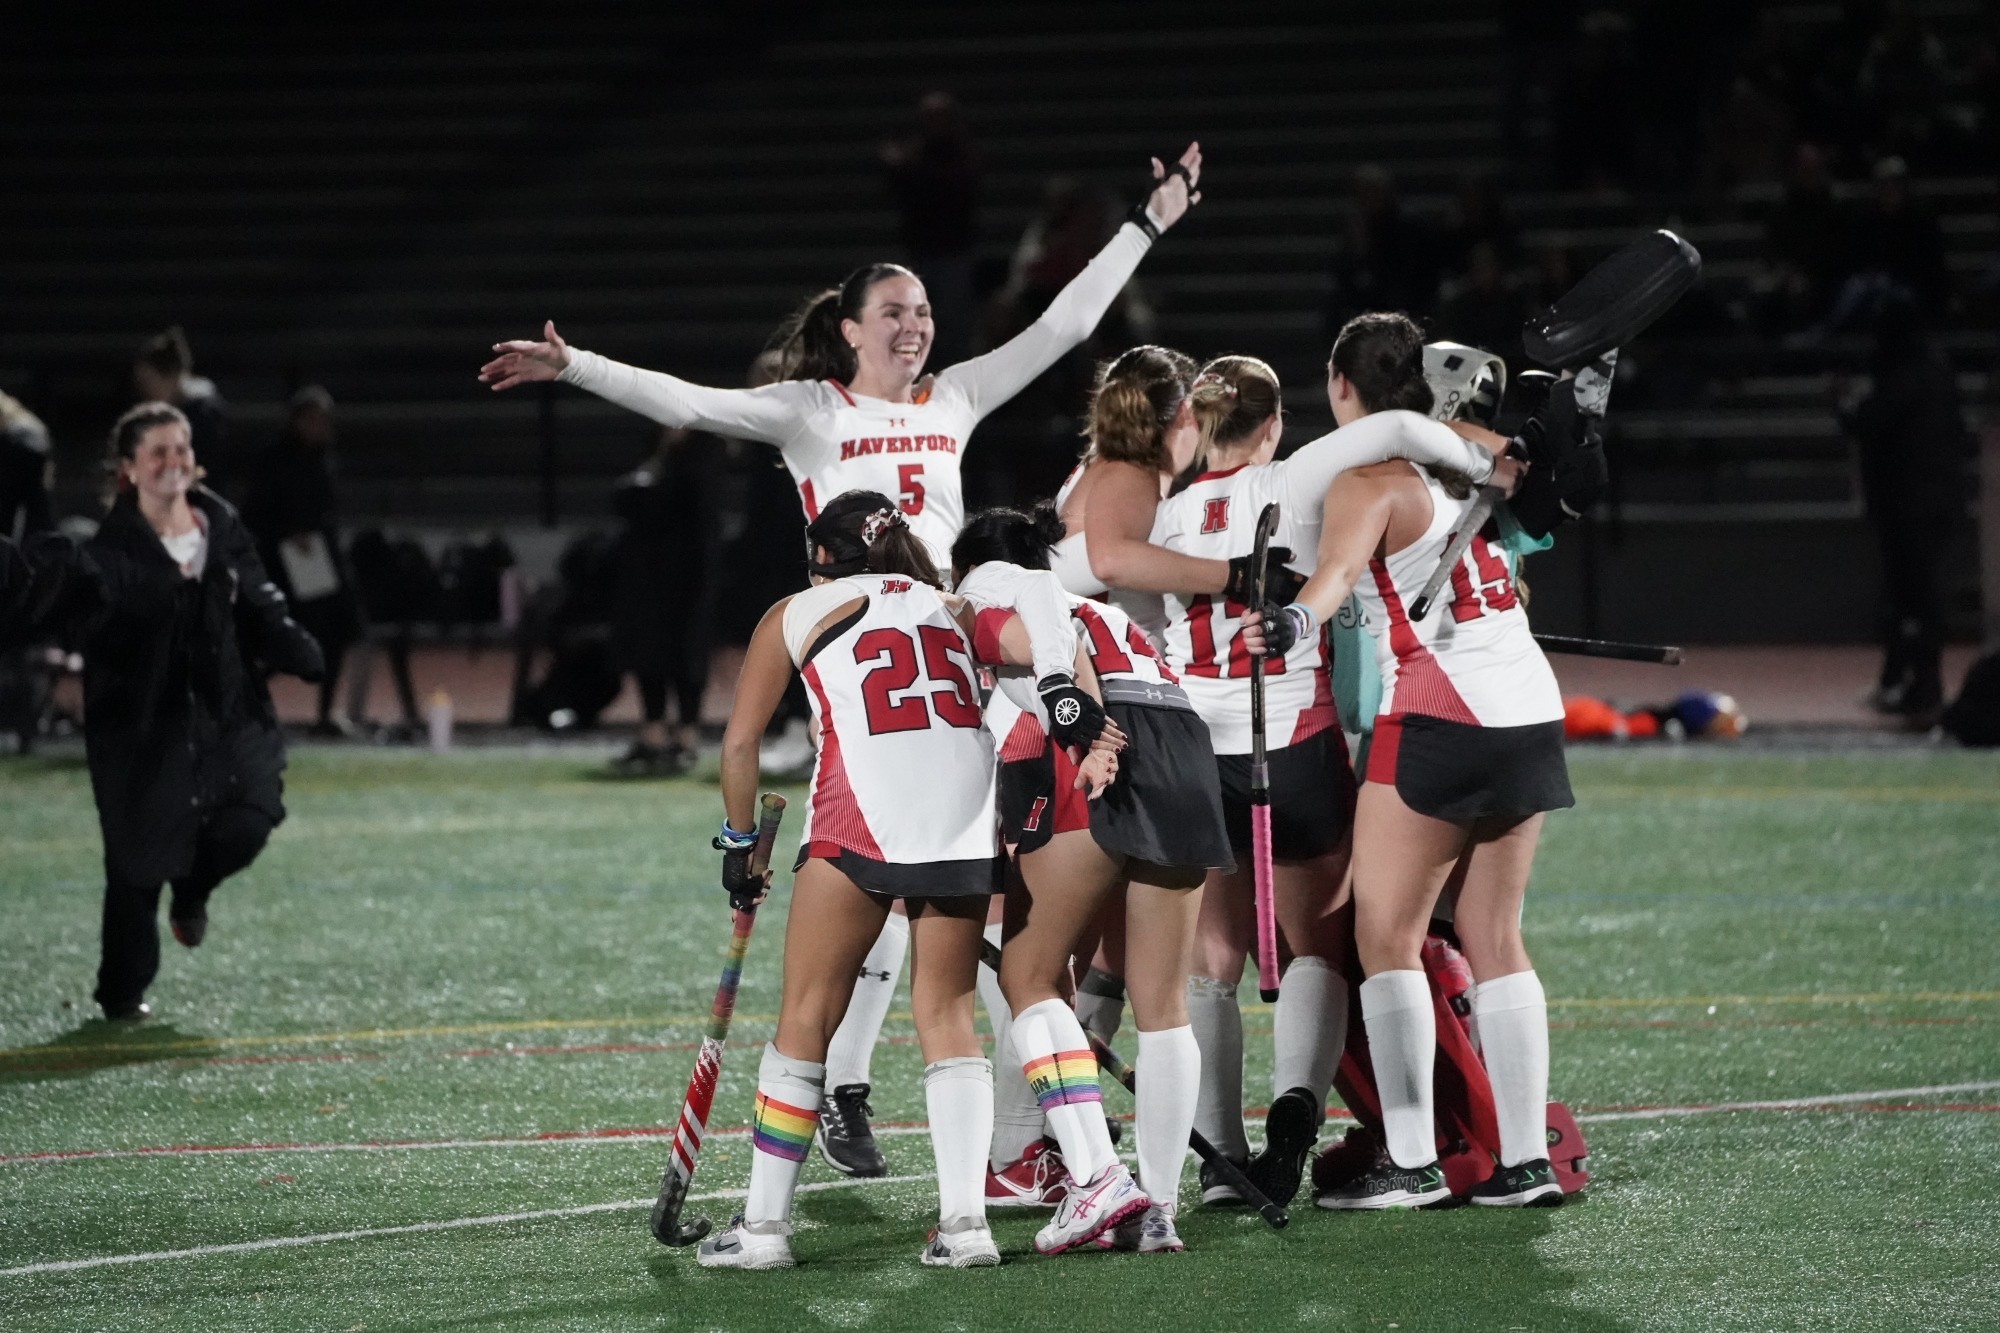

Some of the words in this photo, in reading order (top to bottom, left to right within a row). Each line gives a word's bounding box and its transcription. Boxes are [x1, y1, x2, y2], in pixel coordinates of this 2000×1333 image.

[898, 464, 925, 516] 5
[1200, 496, 1230, 535] H
[881, 580, 912, 594] H
[853, 625, 982, 736] 25
[1366, 1175, 1421, 1196] OSAKA
